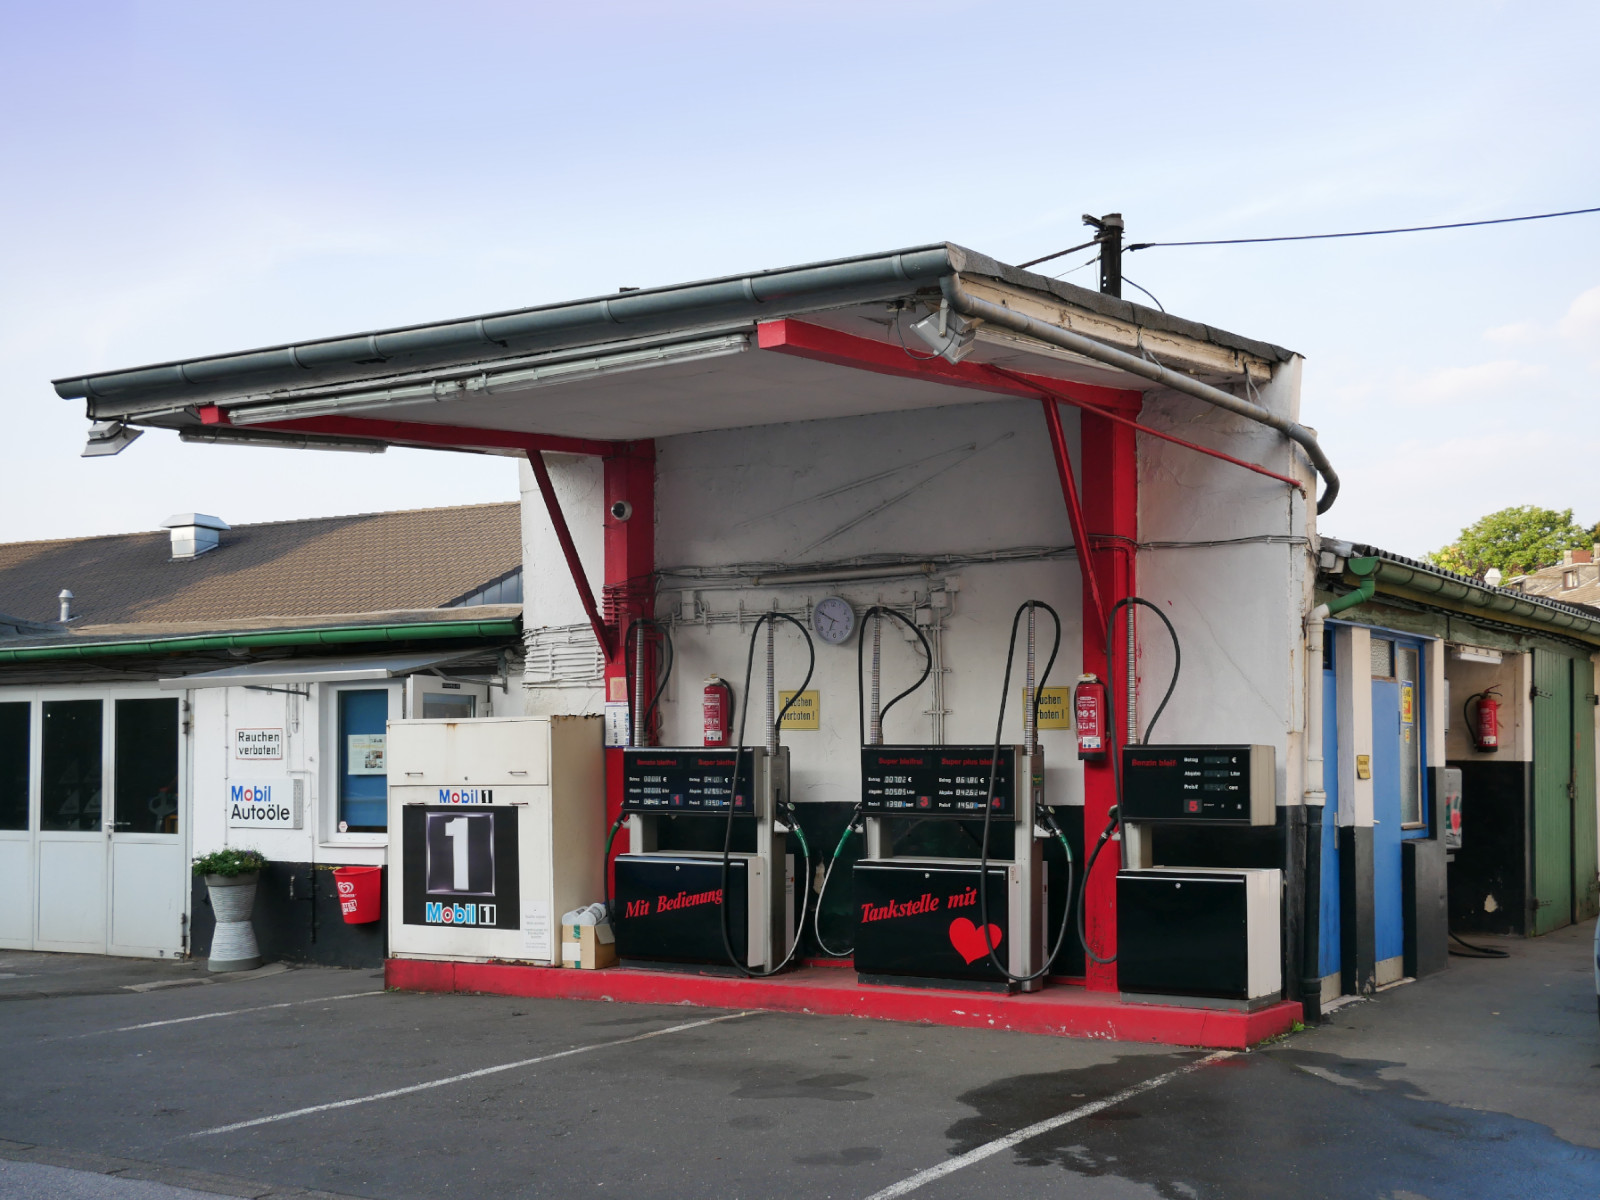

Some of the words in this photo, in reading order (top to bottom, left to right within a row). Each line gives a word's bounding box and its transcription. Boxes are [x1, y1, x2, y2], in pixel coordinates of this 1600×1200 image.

[1039, 694, 1062, 705] uchen
[238, 731, 280, 742] Rauchen
[238, 744, 280, 755] verboten!
[1131, 758, 1157, 767] Benzin
[231, 785, 271, 802] Mobil
[439, 789, 478, 804] Mobil
[673, 794, 680, 805] 1
[735, 795, 743, 805] 2
[920, 796, 929, 807] 3
[991, 797, 1001, 808] 4
[1188, 800, 1199, 812] 5
[231, 804, 290, 820] Autoöle
[445, 817, 469, 891] 1
[625, 899, 650, 919] Mit
[656, 888, 723, 913] Bedienung
[861, 893, 940, 923] Tankstelle
[947, 886, 977, 909] mit
[425, 902, 476, 925] Mobil
